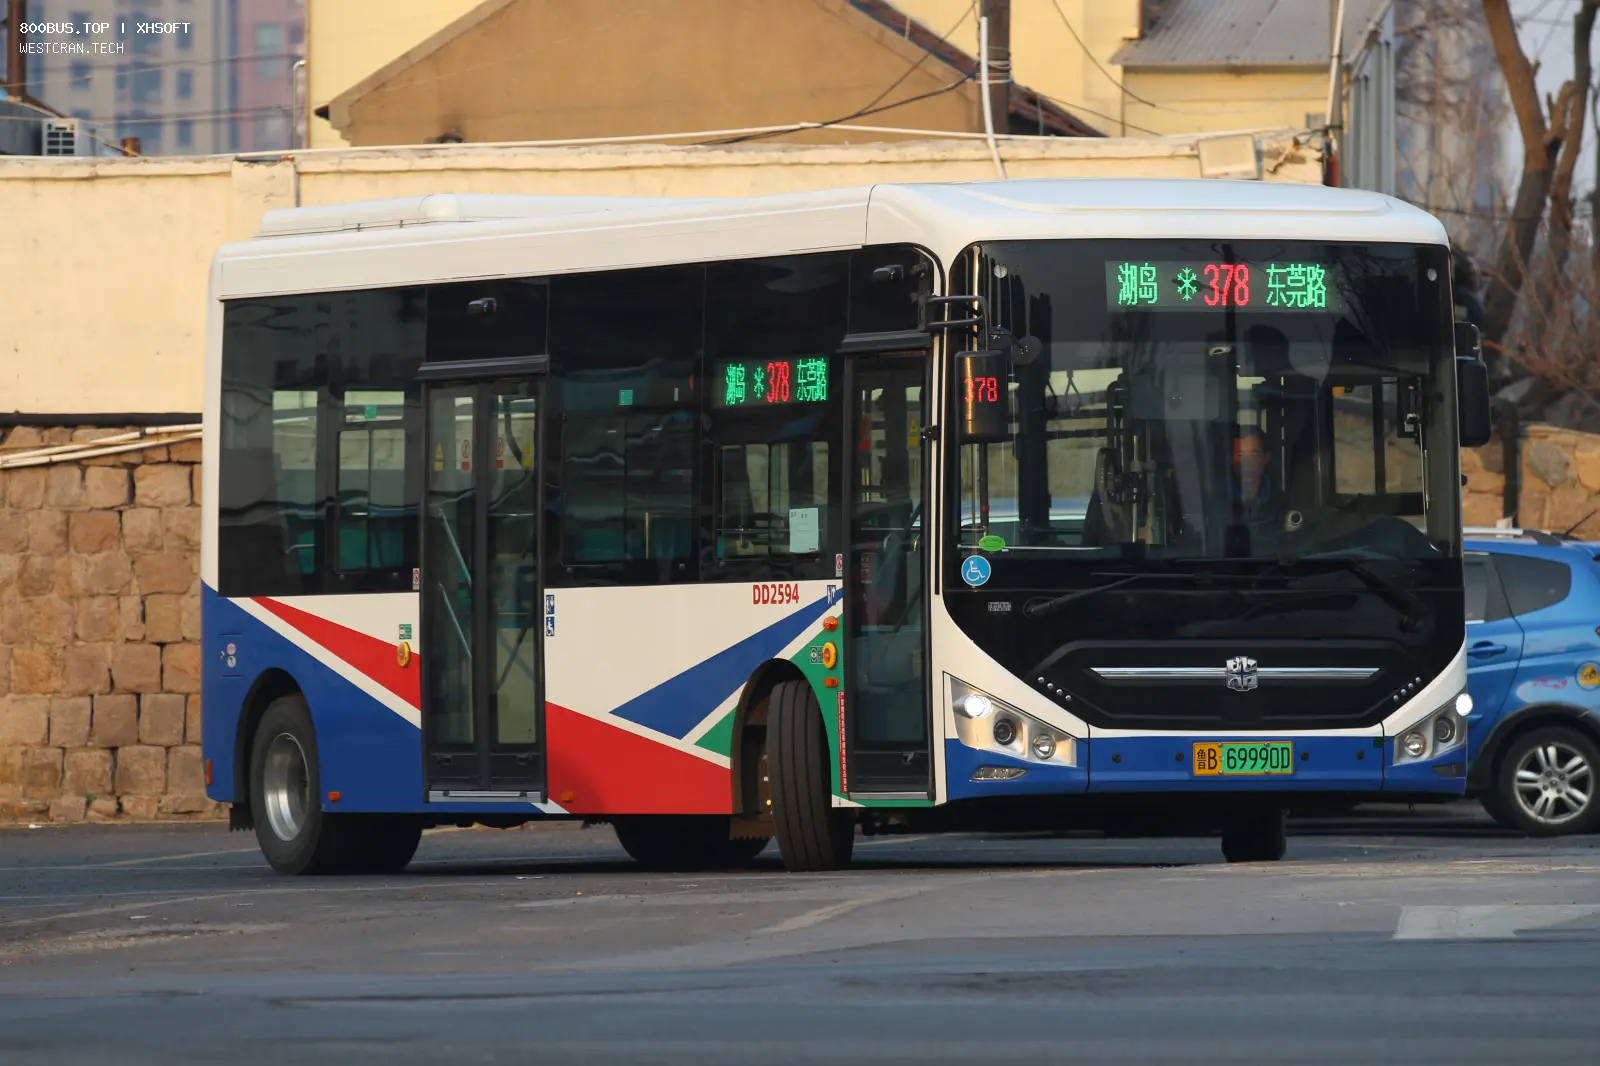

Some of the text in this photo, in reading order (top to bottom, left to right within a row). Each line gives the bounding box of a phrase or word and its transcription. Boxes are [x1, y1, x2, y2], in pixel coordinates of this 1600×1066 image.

[1117, 262, 1327, 307] 湖岛 378 东莞路
[725, 358, 827, 405] 湖岛 378 东莞路
[752, 583, 800, 605] DD2594
